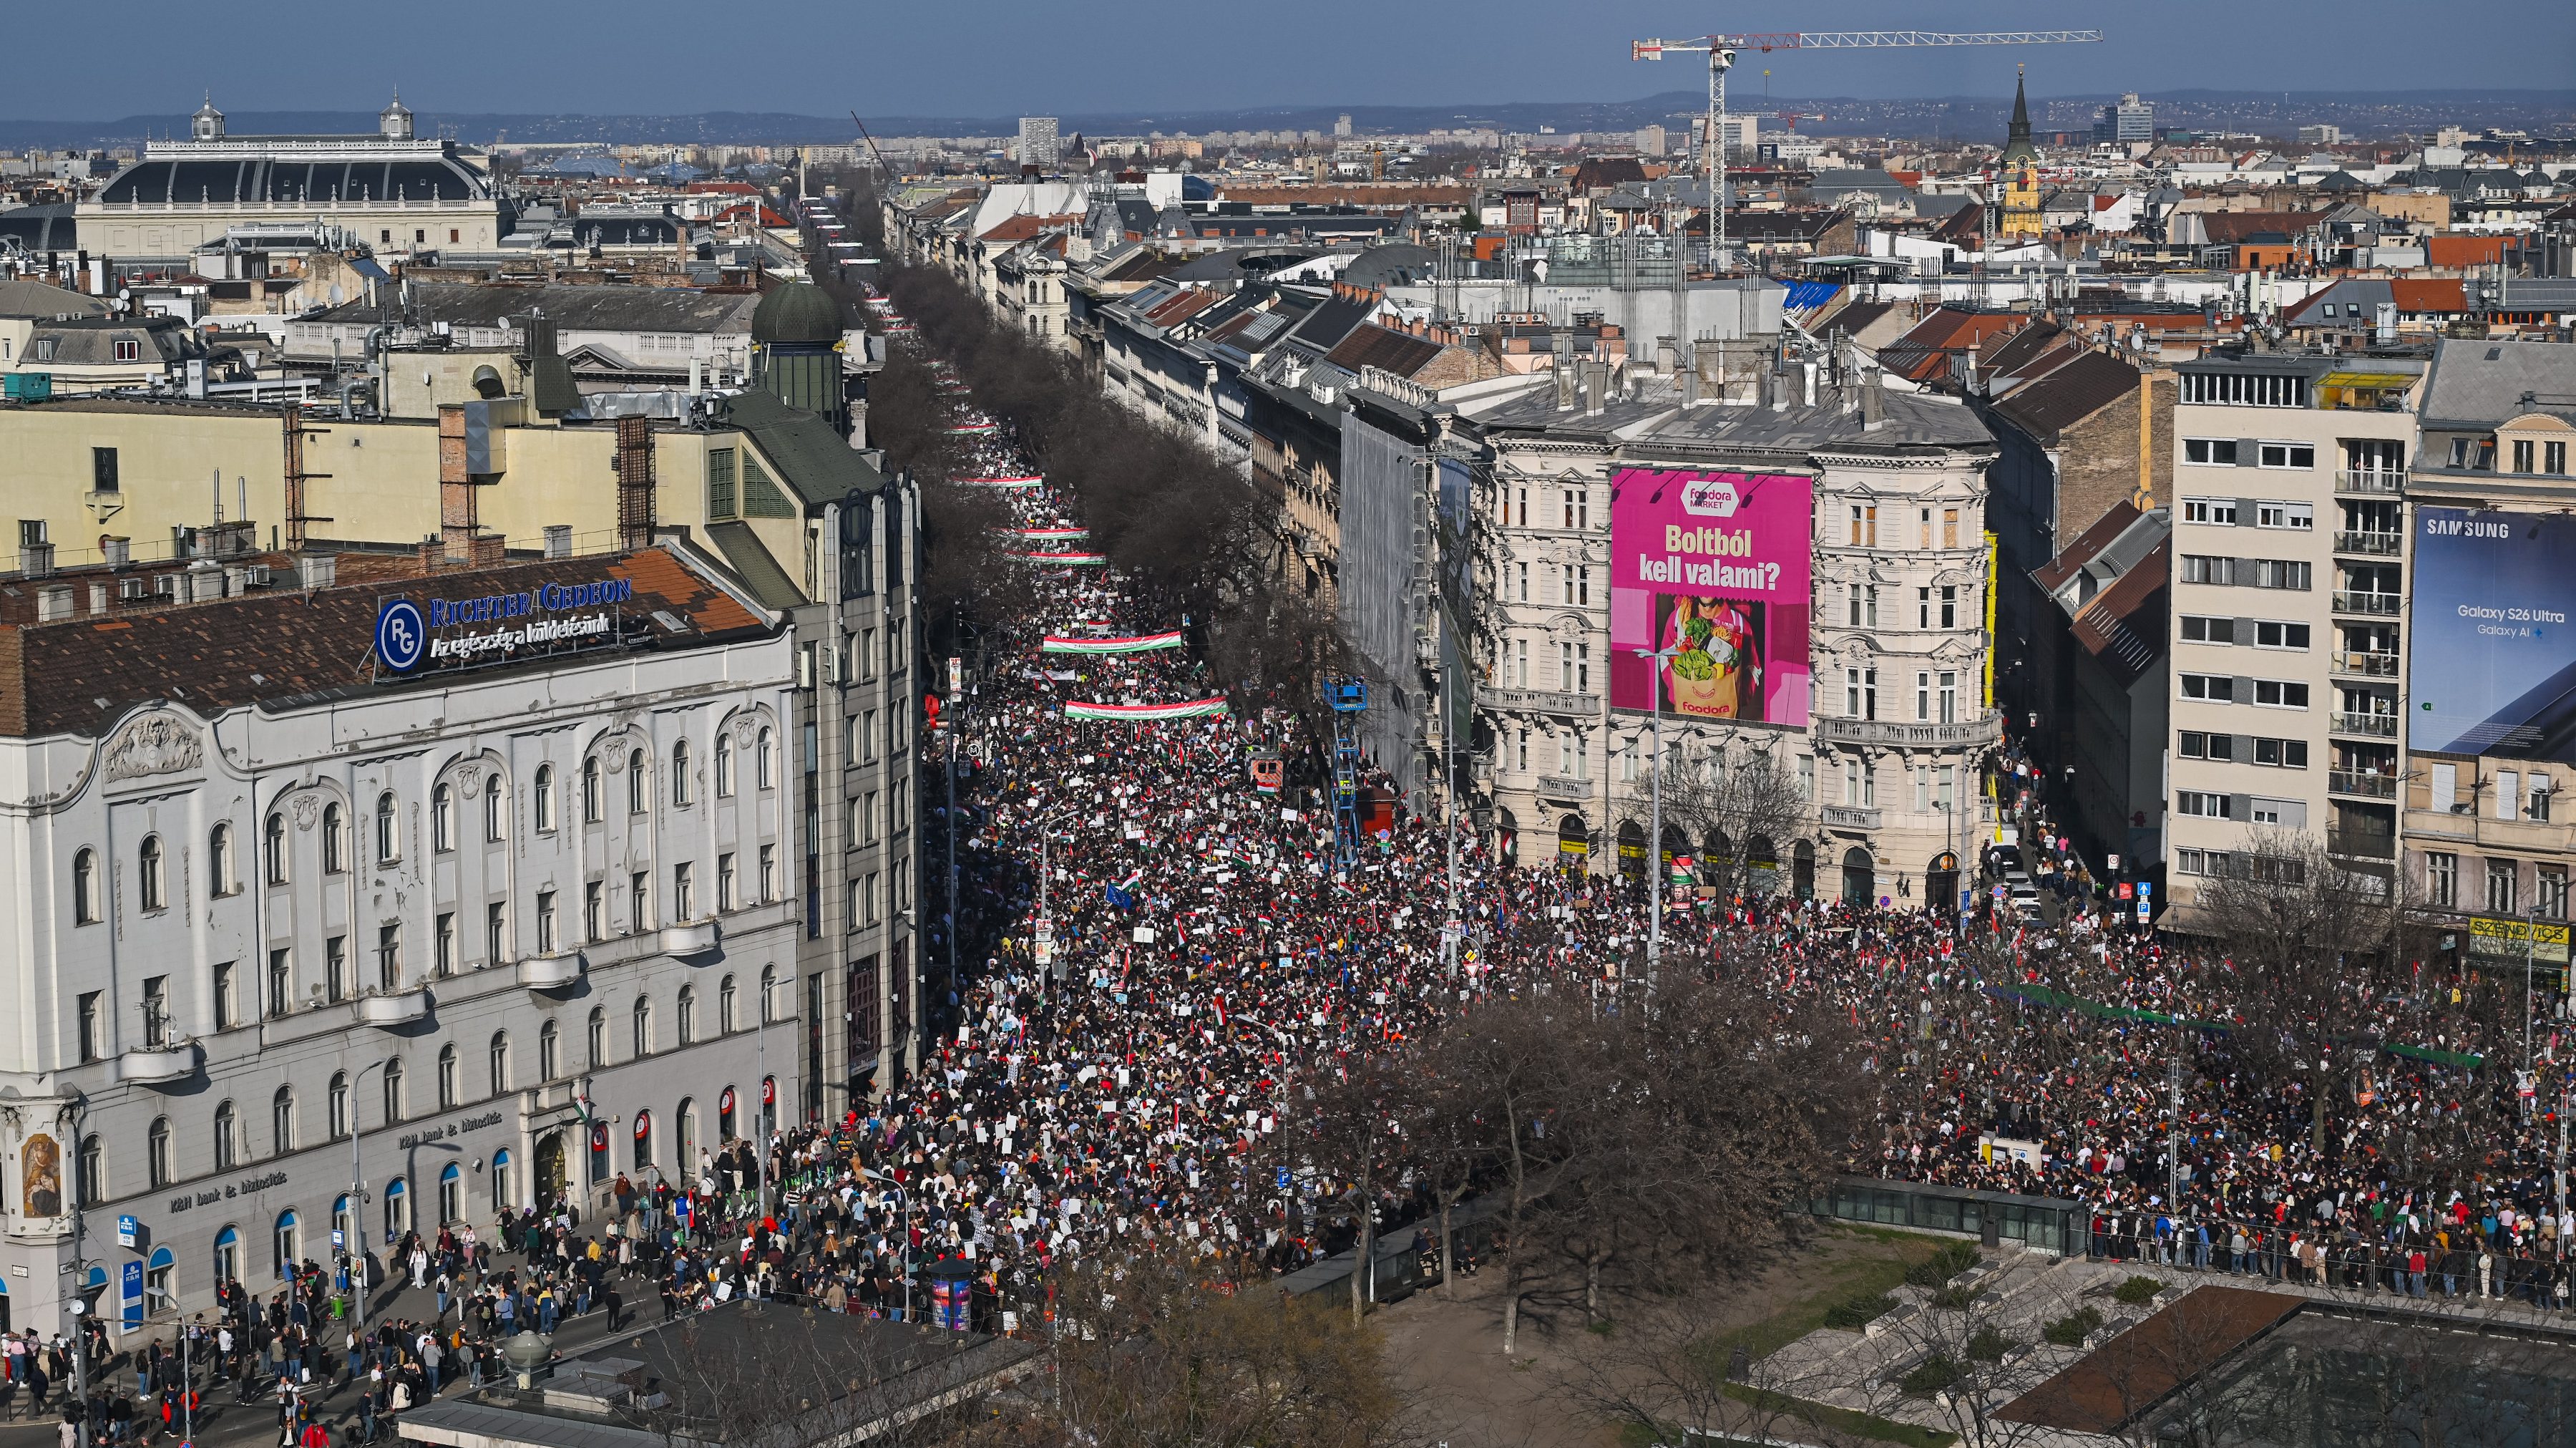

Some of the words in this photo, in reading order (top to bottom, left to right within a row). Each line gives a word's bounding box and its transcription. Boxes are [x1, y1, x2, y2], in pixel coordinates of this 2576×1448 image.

[1690, 487, 1732, 502] foodora
[1690, 500, 1723, 510] MARKET
[2427, 518, 2509, 539] SAMSUNG
[1665, 524, 1752, 558] Boltból
[1639, 553, 1681, 583] kell
[1684, 558, 1780, 591] valami?
[430, 592, 532, 628] RICHTER
[541, 578, 632, 612] GEDEON
[2457, 605, 2505, 623] Galaxy
[2508, 608, 2530, 622] S26
[2532, 609, 2565, 623] Ultra
[430, 638, 449, 659] Az
[450, 627, 515, 659] egészség
[514, 630, 525, 645] a
[526, 612, 610, 645] küldetésünk
[2477, 624, 2517, 639] Galaxy
[2519, 626, 2529, 638] AI
[1682, 701, 1729, 714] foodora
[2474, 920, 2564, 940] SZENDVICS
[399, 1134, 418, 1150] K&H
[421, 1127, 444, 1142] bank
[447, 1123, 458, 1137] és
[460, 1111, 502, 1133] biztosítás
[170, 1196, 192, 1213] K&H
[196, 1187, 221, 1206] bank
[225, 1184, 237, 1199] és
[240, 1170, 288, 1194] biztosítás
